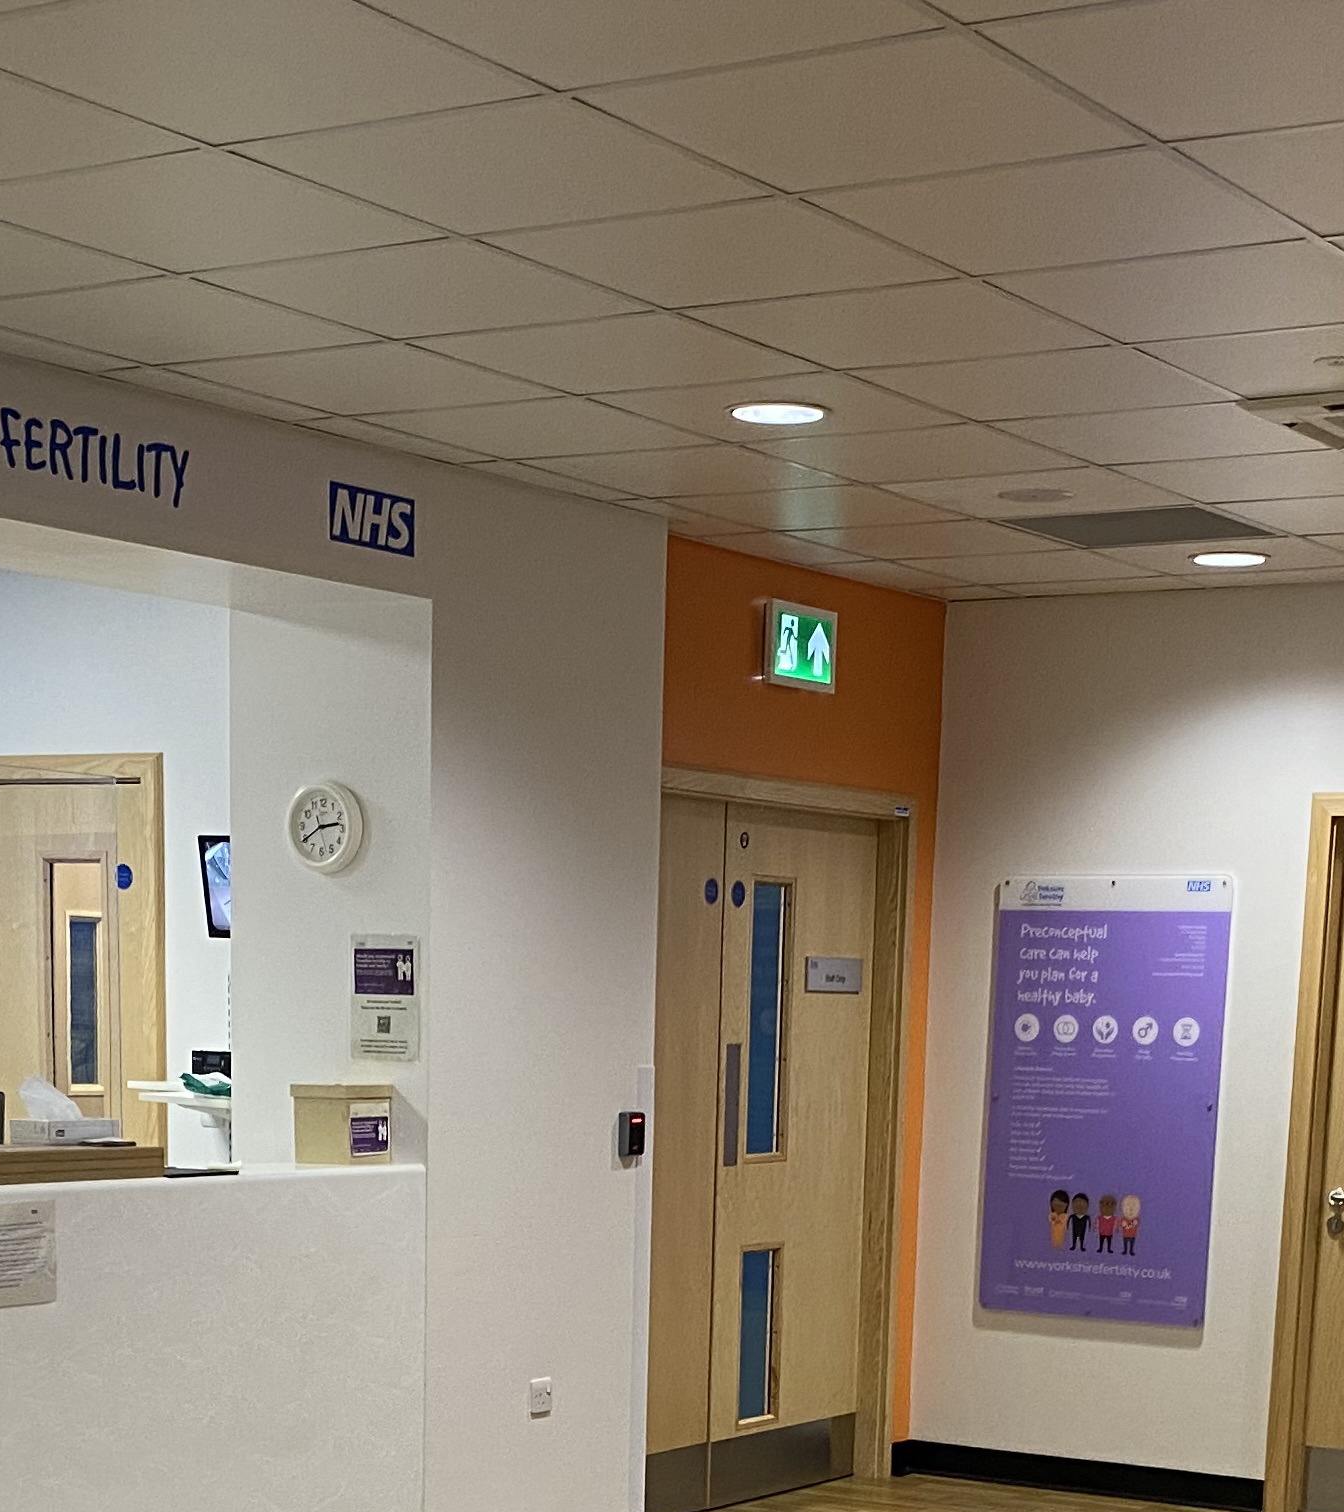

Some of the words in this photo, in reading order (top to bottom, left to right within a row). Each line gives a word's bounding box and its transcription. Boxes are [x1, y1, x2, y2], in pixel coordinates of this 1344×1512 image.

[0, 407, 190, 509] FERTILITY
[331, 487, 412, 551] NHS
[1188, 880, 1211, 892] NHS
[1020, 923, 1108, 943] Preconceptual
[1074, 945, 1099, 963] help
[1017, 969, 1039, 984] you
[1041, 967, 1065, 984] plan
[1069, 966, 1088, 982] for
[1090, 970, 1098, 983] a
[1018, 987, 1063, 1006] healthy
[1065, 988, 1096, 1007] baby.
